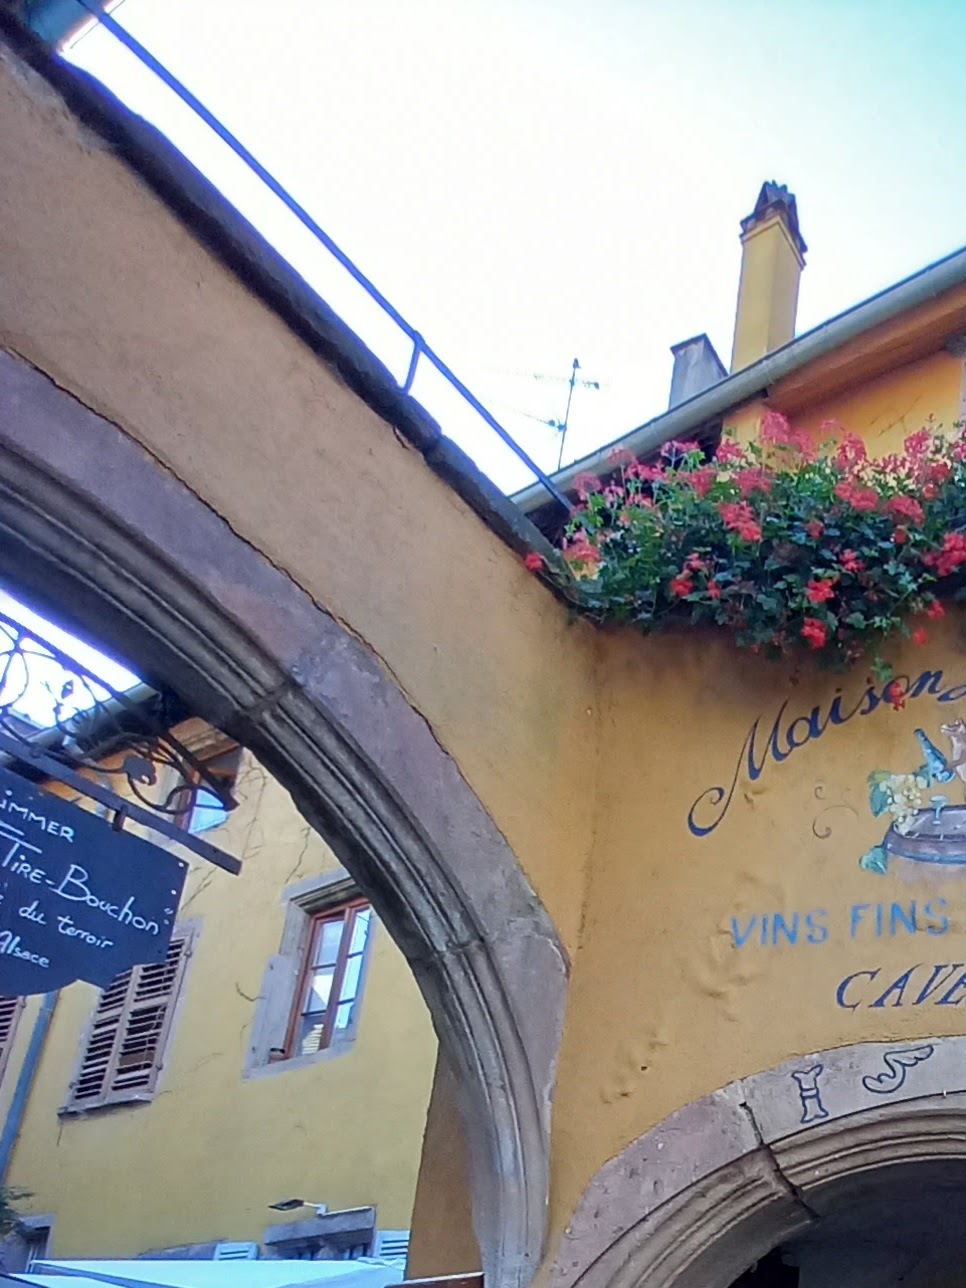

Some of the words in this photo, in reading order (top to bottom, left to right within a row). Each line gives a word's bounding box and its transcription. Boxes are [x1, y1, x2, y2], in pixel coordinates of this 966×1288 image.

[688, 666, 942, 837] Maison
[19, 900, 47, 925] du
[57, 915, 113, 949] terroir
[731, 911, 829, 950] VINS
[849, 897, 951, 940] FINS
